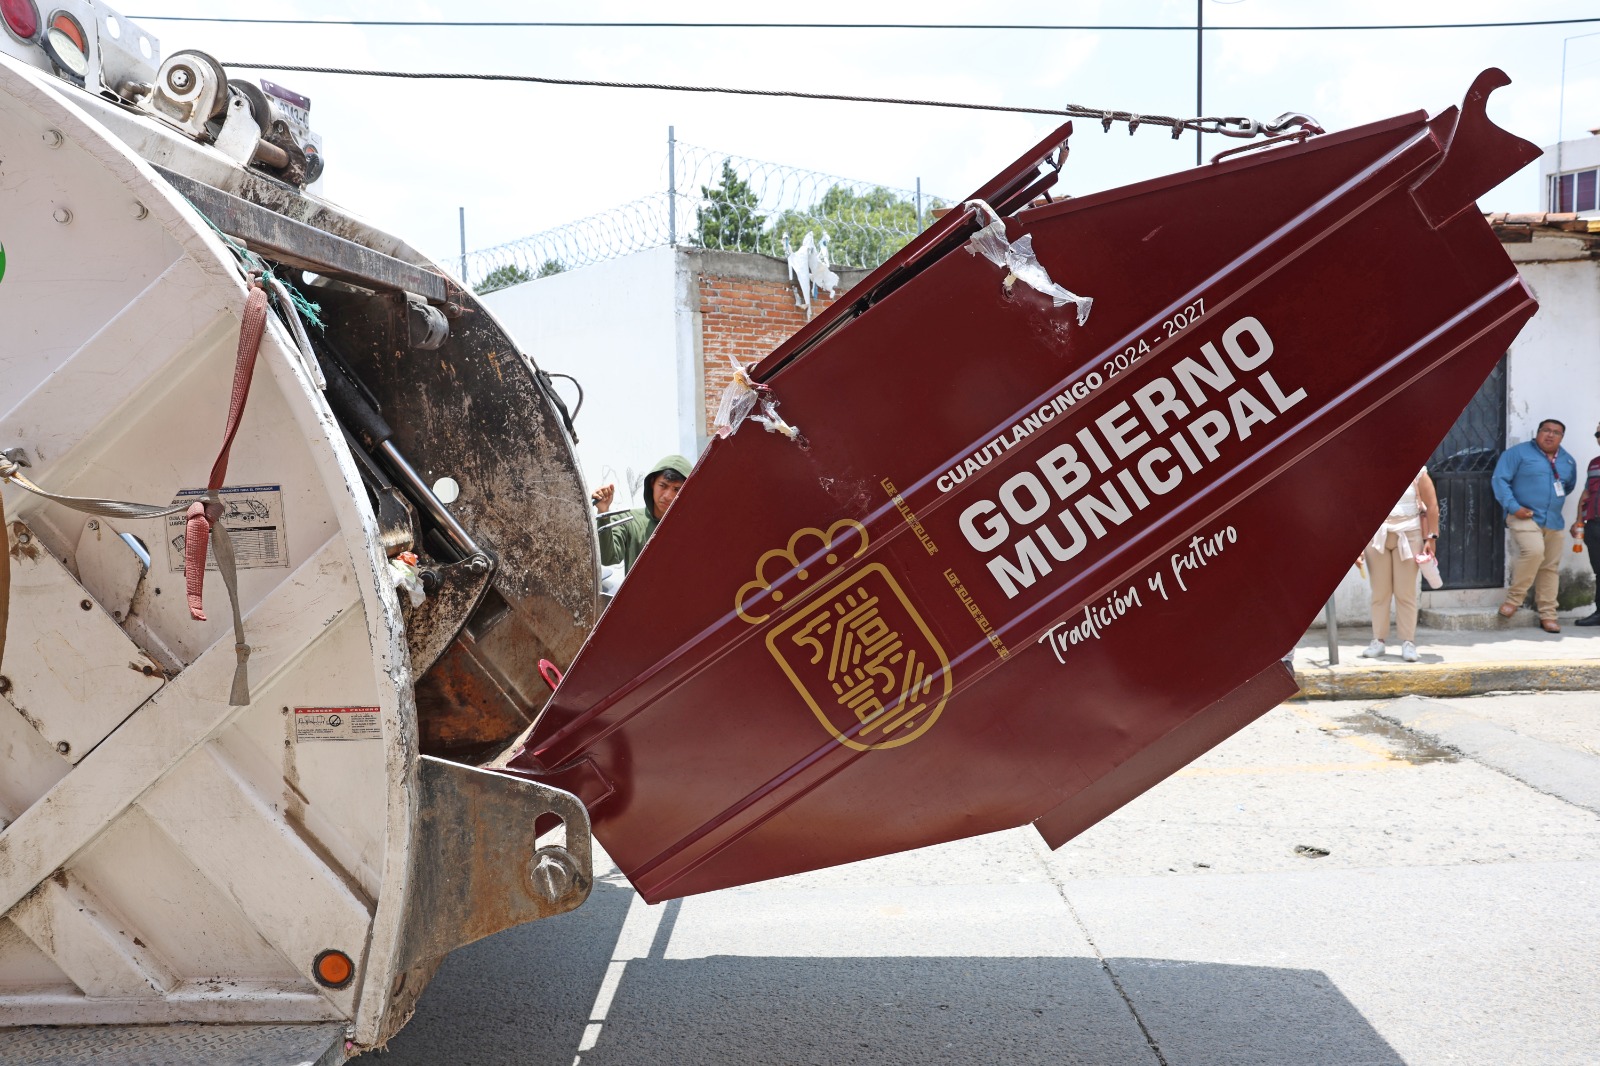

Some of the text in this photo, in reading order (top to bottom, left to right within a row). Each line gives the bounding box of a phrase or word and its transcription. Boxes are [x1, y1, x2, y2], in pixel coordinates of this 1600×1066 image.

[937, 373, 1103, 493] CUAUTLANCINGO
[1104, 339, 1151, 379] 2024
[1163, 298, 1206, 338] 2027
[958, 316, 1274, 553] GOBIERNO
[985, 370, 1308, 600] MUNICIPAL
[1038, 587, 1143, 665] Tradición
[1147, 572, 1169, 601] y
